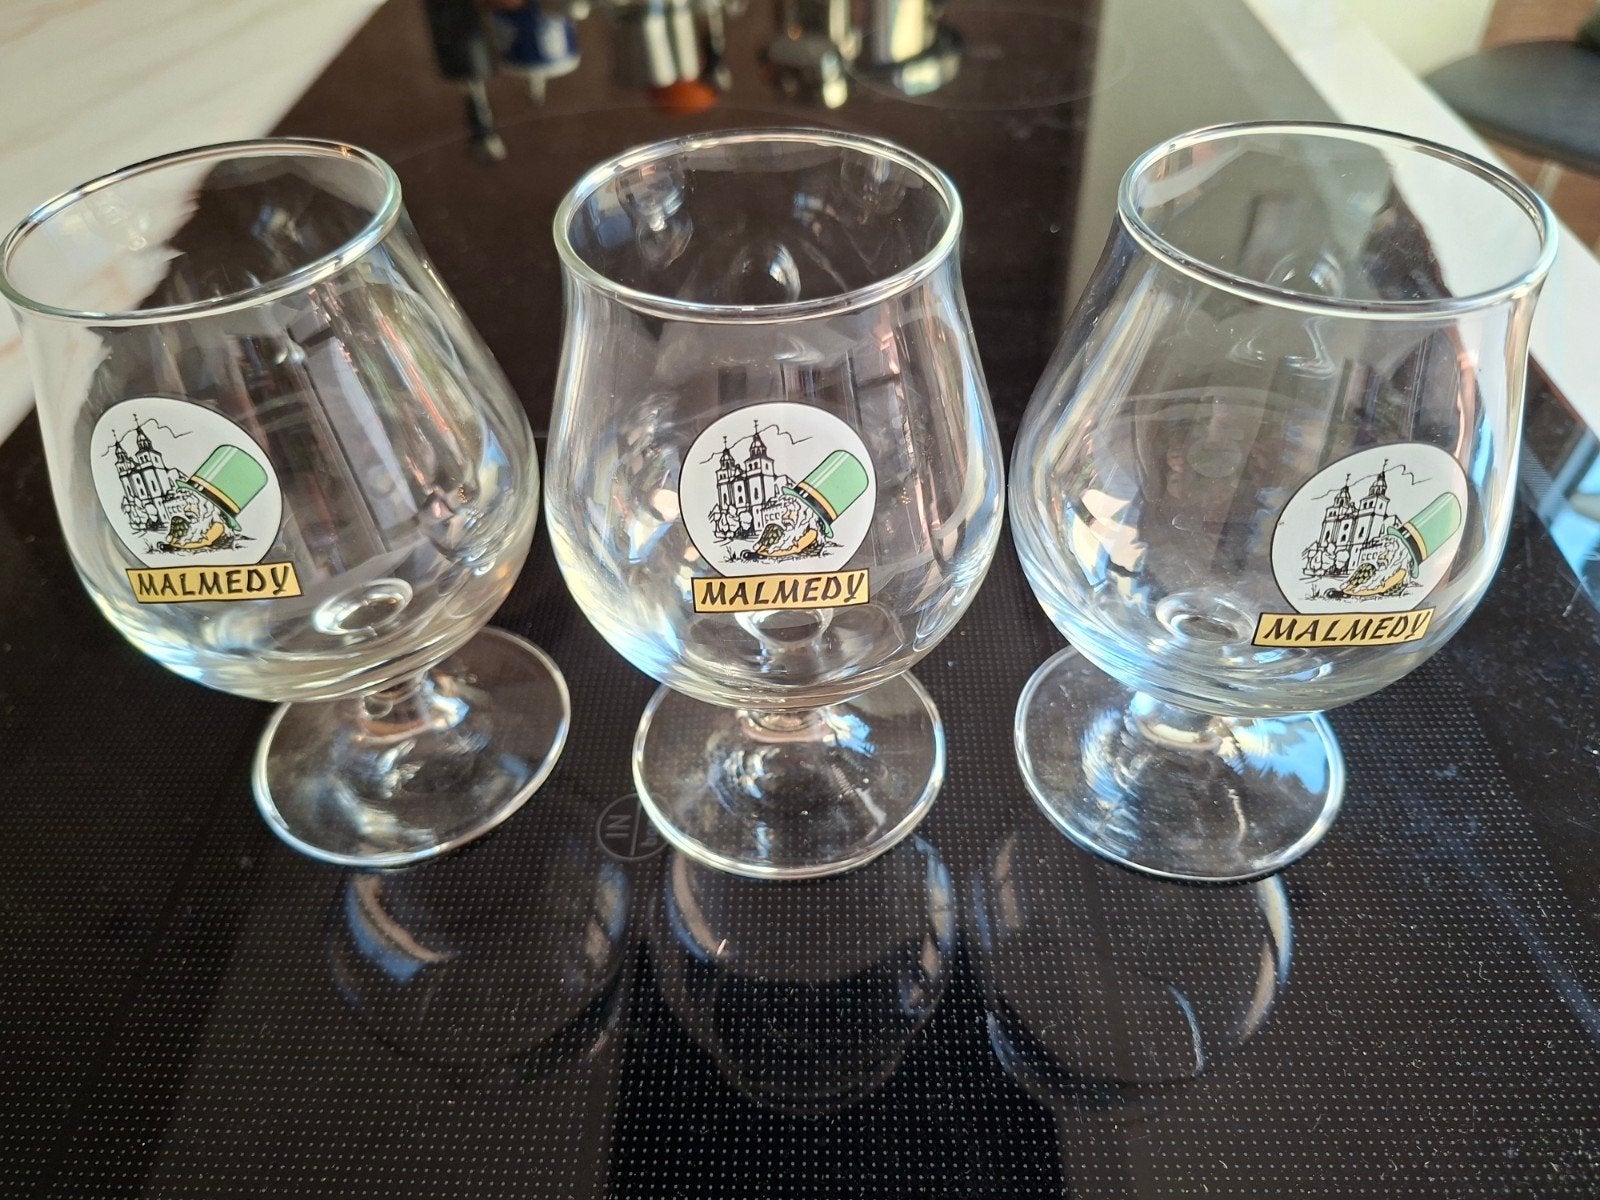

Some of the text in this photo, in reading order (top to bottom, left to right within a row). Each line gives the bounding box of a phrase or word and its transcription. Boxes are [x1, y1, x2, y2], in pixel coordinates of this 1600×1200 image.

[139, 566, 290, 596] MALMEDY
[700, 572, 865, 605] MALMEDY
[1262, 611, 1431, 642] MALMEDY
